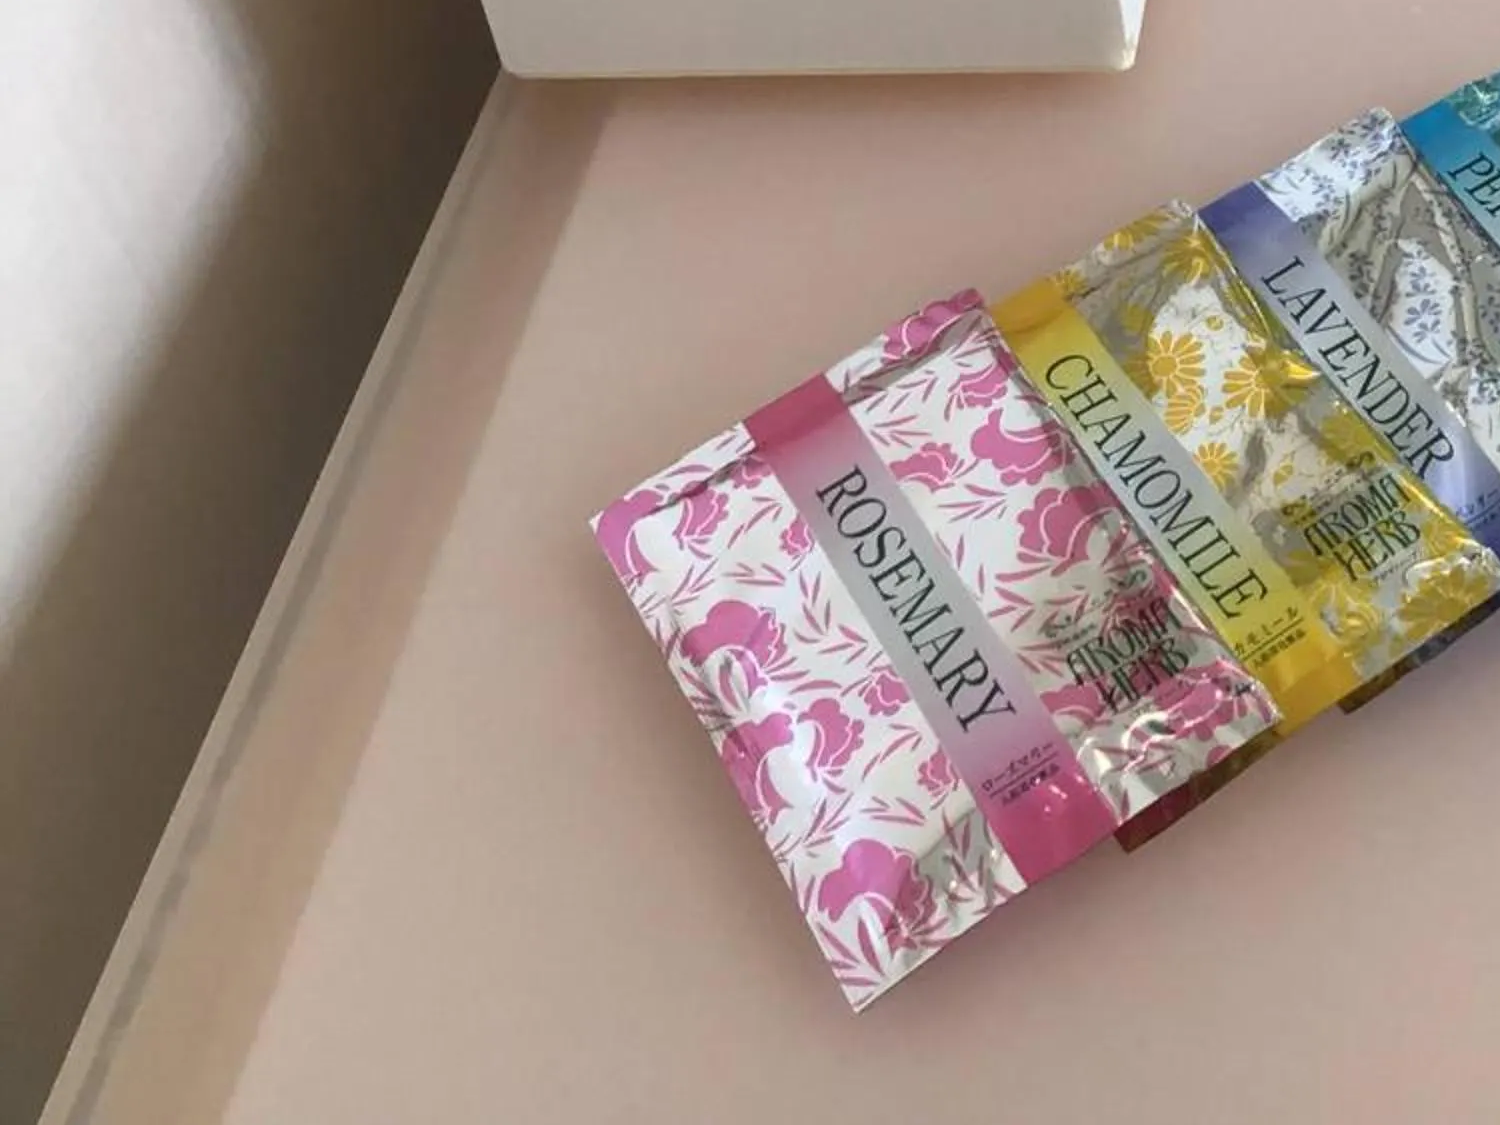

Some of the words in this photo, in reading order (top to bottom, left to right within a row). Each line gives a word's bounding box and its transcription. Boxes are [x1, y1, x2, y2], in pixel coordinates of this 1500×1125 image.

[1261, 256, 1457, 478] LAVENDER
[1045, 353, 1268, 619] CHAMOMILE
[1303, 473, 1412, 557] AROMA
[1333, 510, 1421, 582] HERB
[816, 465, 1015, 733] ROSEMARY
[1066, 597, 1183, 686] AROMA
[1095, 637, 1190, 715] HERB
[981, 742, 1054, 792] ローズマリー
